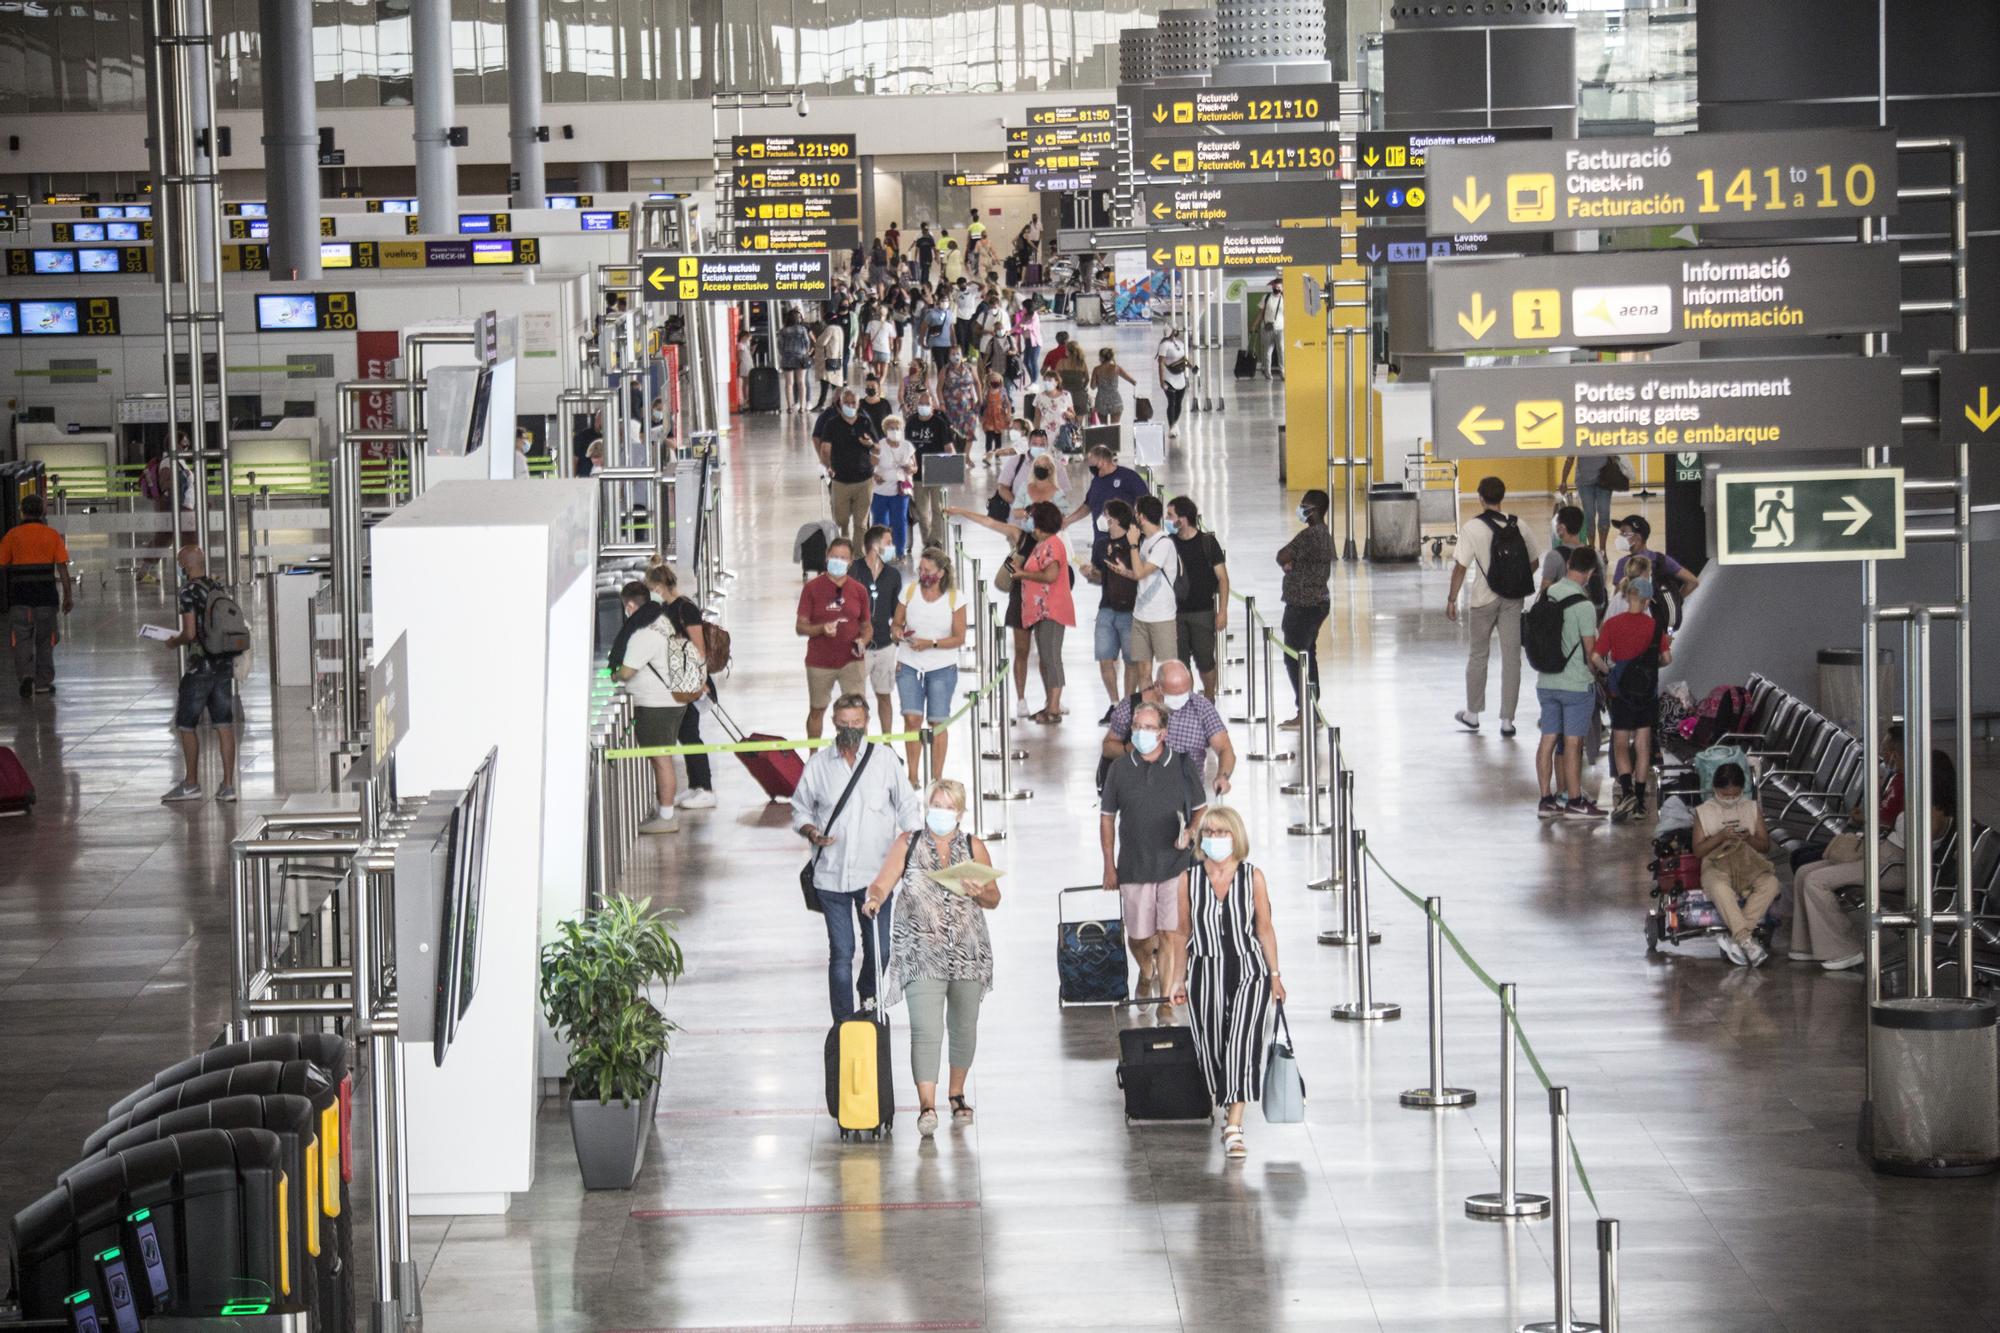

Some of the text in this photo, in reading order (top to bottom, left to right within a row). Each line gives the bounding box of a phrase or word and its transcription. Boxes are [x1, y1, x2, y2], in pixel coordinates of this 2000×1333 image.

[1196, 92, 1239, 103] Facturació
[1196, 103, 1228, 112] Check-in
[1248, 100, 1284, 120] 121
[1294, 99, 1319, 118] 10
[1079, 110, 1092, 121] 81
[1096, 110, 1110, 120] 50
[1197, 112, 1244, 122] Facturación
[1080, 132, 1094, 143] 41
[1096, 132, 1110, 142] 10
[798, 143, 848, 157] 121 90
[1197, 141, 1240, 152] Facturació
[1197, 152, 1230, 160] Check-in
[1250, 149, 1286, 170] 141
[1297, 148, 1336, 168] 130
[1566, 146, 1672, 172] Facturació
[1198, 160, 1246, 170] Facturación
[800, 173, 840, 187] 81 10
[1567, 174, 1644, 194] Check-in
[1696, 163, 1876, 213] 141 to 10
[1175, 192, 1198, 200] Carril
[1567, 192, 1805, 218] Facturación a
[1175, 210, 1227, 221] Carril rápido
[1250, 236, 1284, 244] exclusiu
[1454, 234, 1488, 242] Lavabos
[1454, 243, 1478, 251] Toilets
[384, 249, 418, 260] vueling
[430, 252, 466, 260] CHECK-IN
[520, 252, 536, 264] 90
[1224, 254, 1293, 265] Acceso exclusivo
[126, 262, 143, 272] 93
[245, 258, 262, 270] 92
[359, 256, 374, 268] 91
[775, 262, 798, 272] Carril
[12, 264, 28, 274] 94
[1682, 258, 1791, 283] Informació
[776, 273, 790, 281] Fast
[702, 282, 769, 292] Acceso exclusivo
[776, 280, 826, 292] Carril rápido
[1682, 284, 1784, 306] Information
[1619, 304, 1659, 316] aena
[322, 313, 356, 329] 130
[1684, 305, 1804, 330] Información
[86, 318, 116, 334] 131
[1574, 378, 1792, 402] Portes d'embarcament
[1574, 404, 1700, 426] Boarding gates
[1576, 423, 1781, 448] Puertas de embarque
[1679, 472, 1702, 481] DEA
